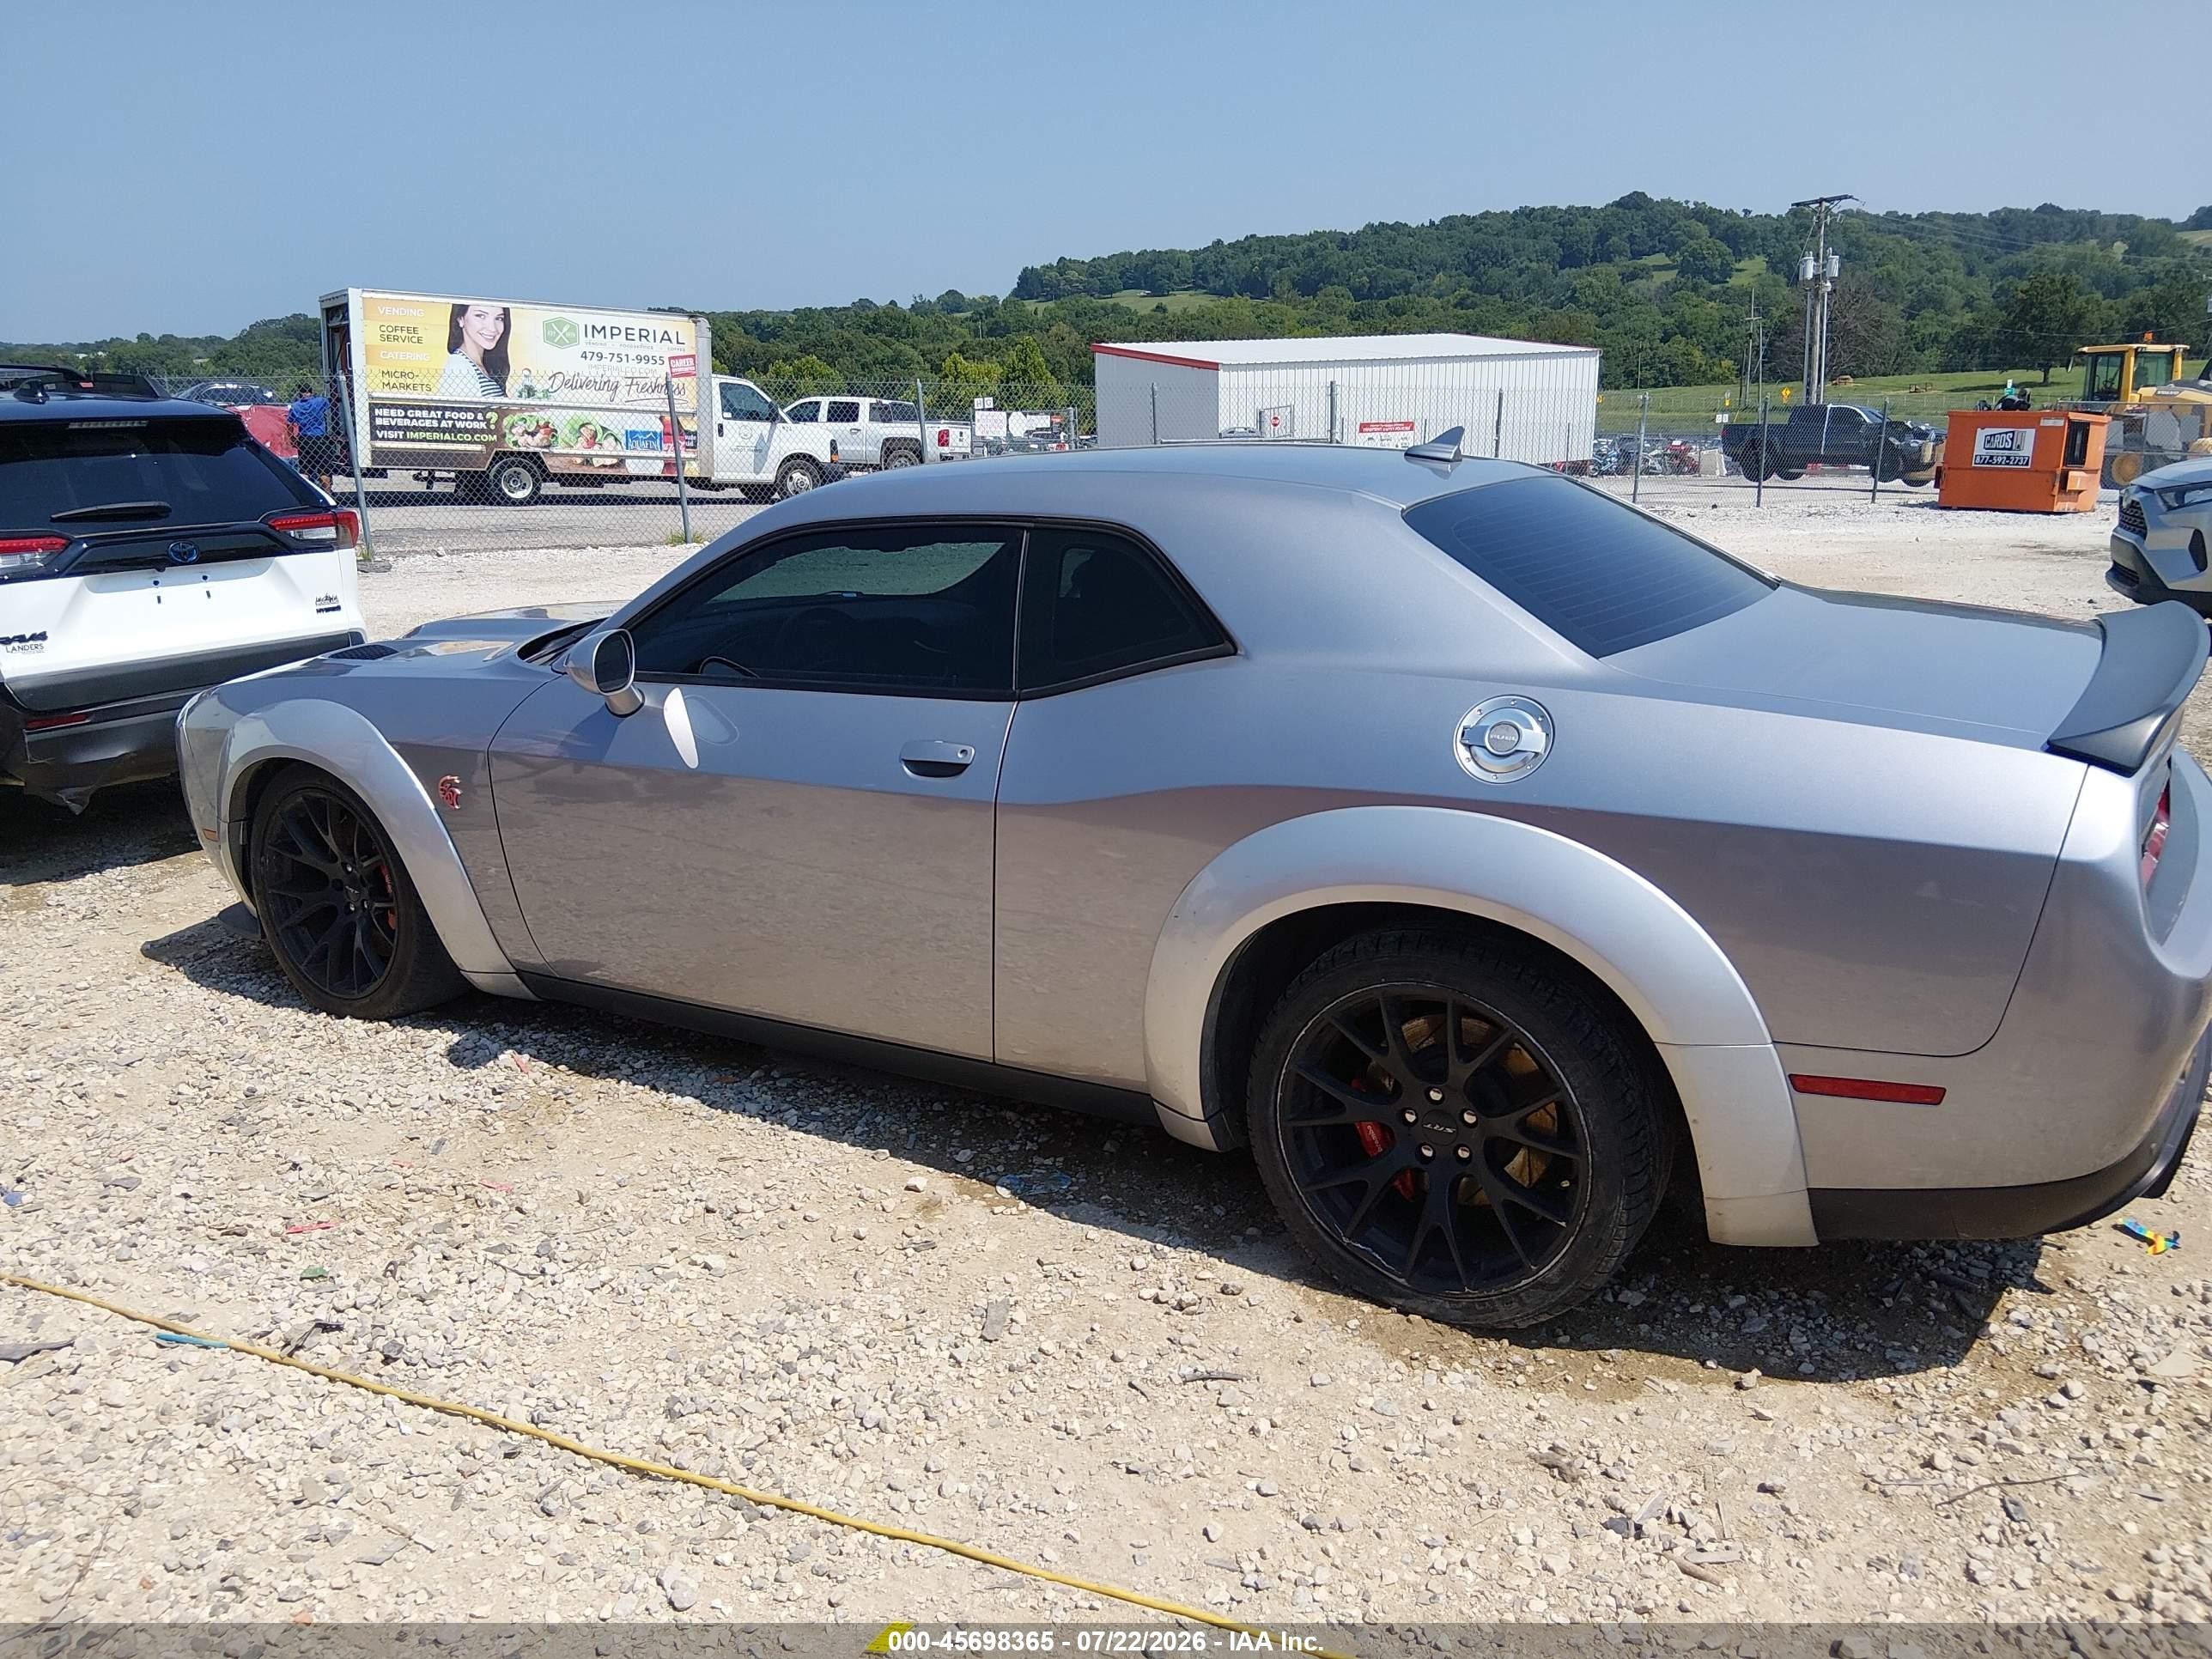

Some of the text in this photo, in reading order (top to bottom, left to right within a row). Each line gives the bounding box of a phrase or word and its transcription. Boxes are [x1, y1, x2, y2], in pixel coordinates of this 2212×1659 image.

[378, 306, 425, 317] VENDING
[379, 325, 420, 335] COFFEE
[584, 324, 685, 345] IMPERIAL
[379, 333, 424, 344] SERVICE
[380, 350, 430, 362] CATERING
[580, 350, 665, 366] 479-751-9955
[381, 370, 420, 380] MICRO-
[382, 381, 432, 392] MARKETS
[548, 371, 686, 402] Delivering Freshnss
[374, 408, 404, 417] NEED
[407, 410, 442, 419] GREAT
[444, 410, 475, 421] FOOD
[375, 417, 439, 428] BEVERAGES
[440, 420, 453, 428] AT
[376, 430, 497, 442] VISIT IMPERIALCO.COM
[1975, 456, 2028, 465] 877-592-2737
[6, 643, 45, 653] LANDERS
[1423, 1122, 1456, 1133] SRT
